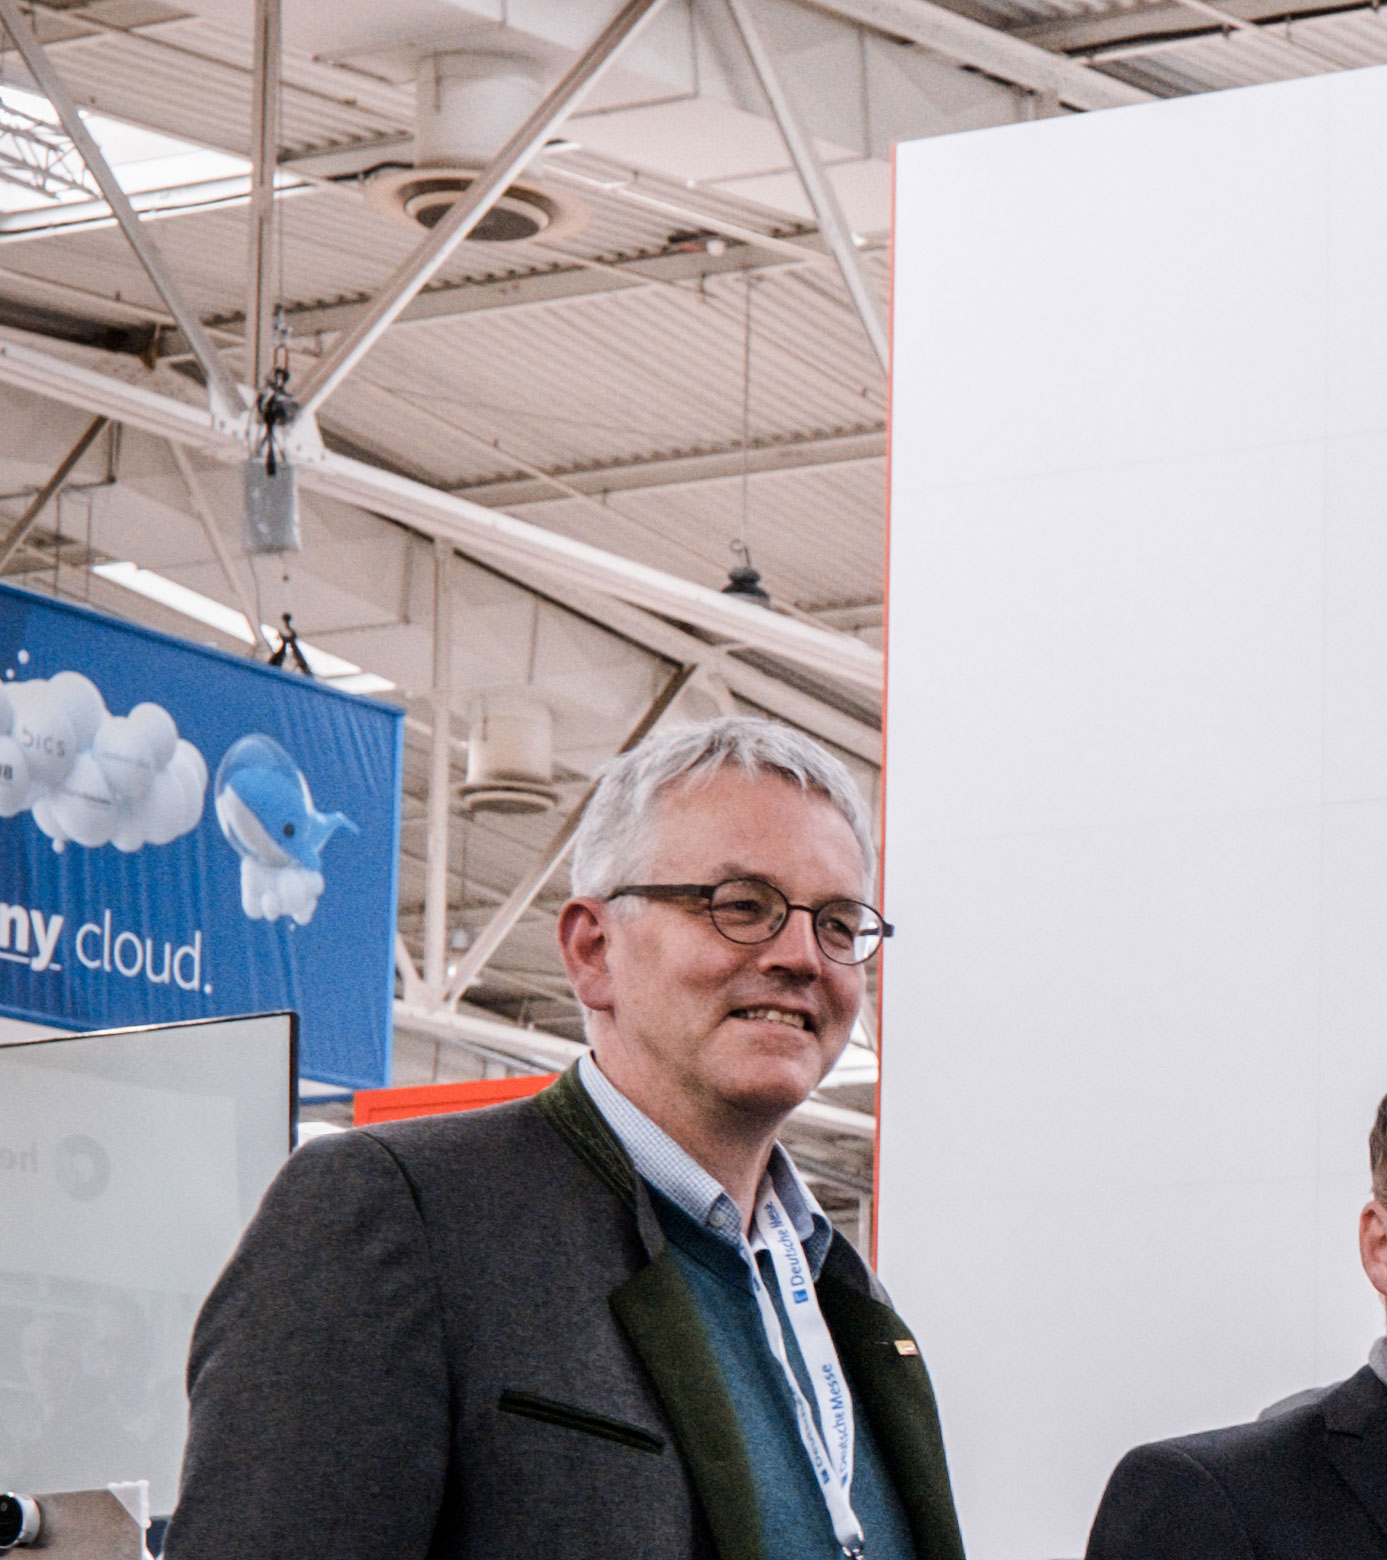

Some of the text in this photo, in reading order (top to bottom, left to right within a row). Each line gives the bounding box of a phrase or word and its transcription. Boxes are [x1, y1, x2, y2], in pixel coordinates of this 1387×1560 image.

[75, 908, 213, 995] cloud.
[778, 1228, 806, 1287] Deutsche
[821, 1362, 845, 1411] Messe
